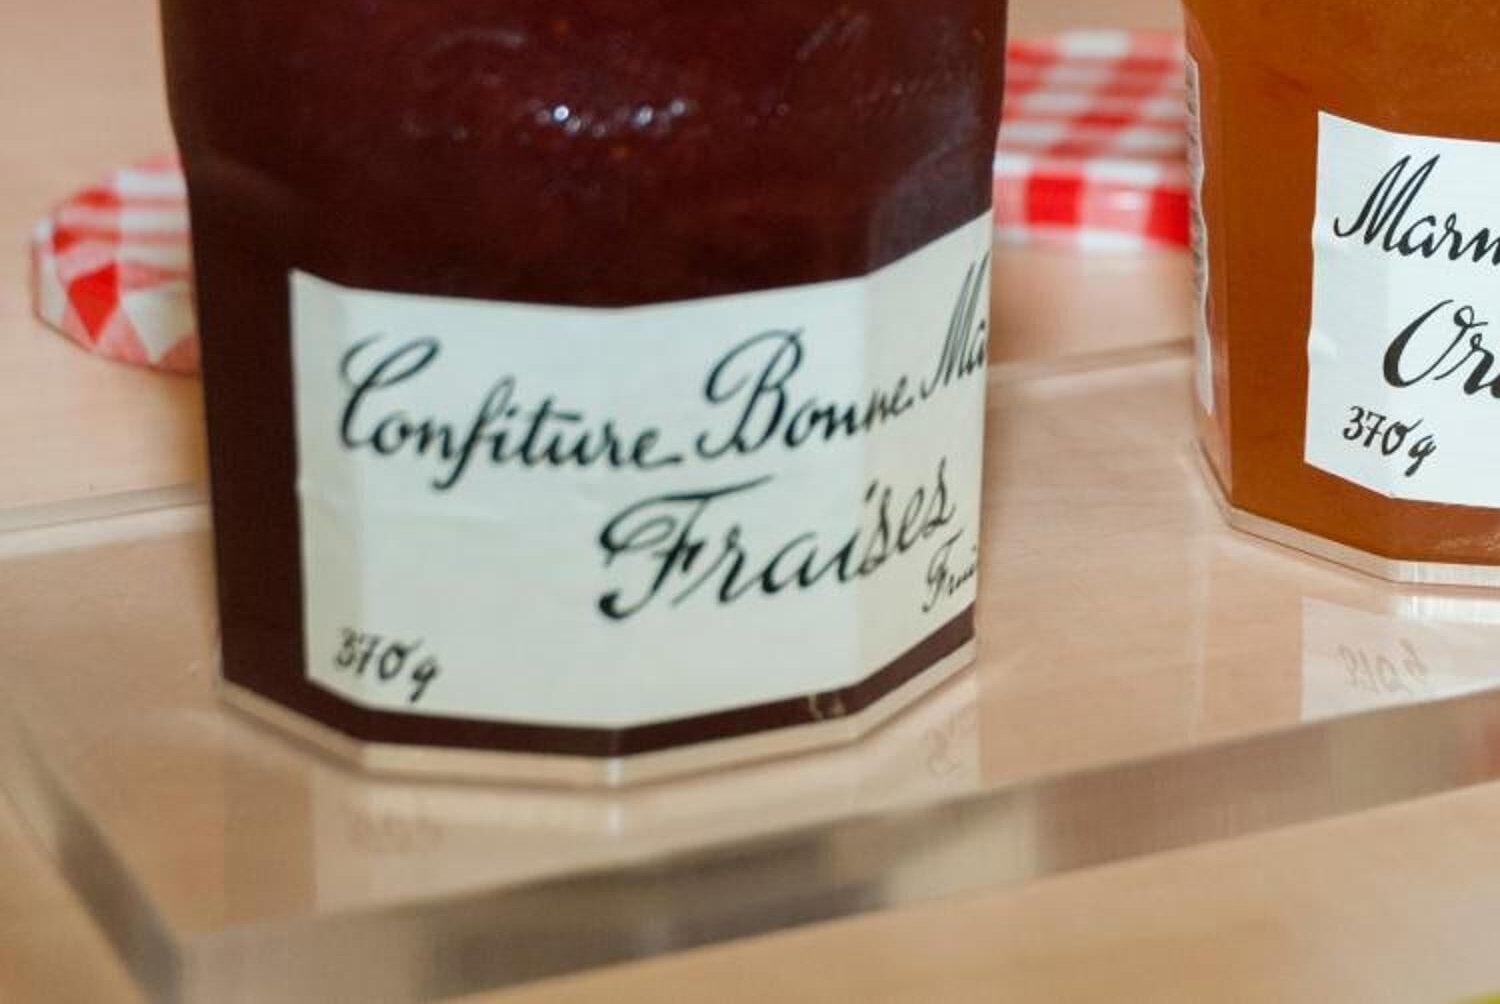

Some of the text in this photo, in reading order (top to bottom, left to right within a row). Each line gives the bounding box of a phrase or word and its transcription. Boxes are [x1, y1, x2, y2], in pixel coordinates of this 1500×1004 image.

[338, 333, 682, 490] Confiture
[683, 328, 913, 457] Bonne
[599, 455, 958, 621] Fraises
